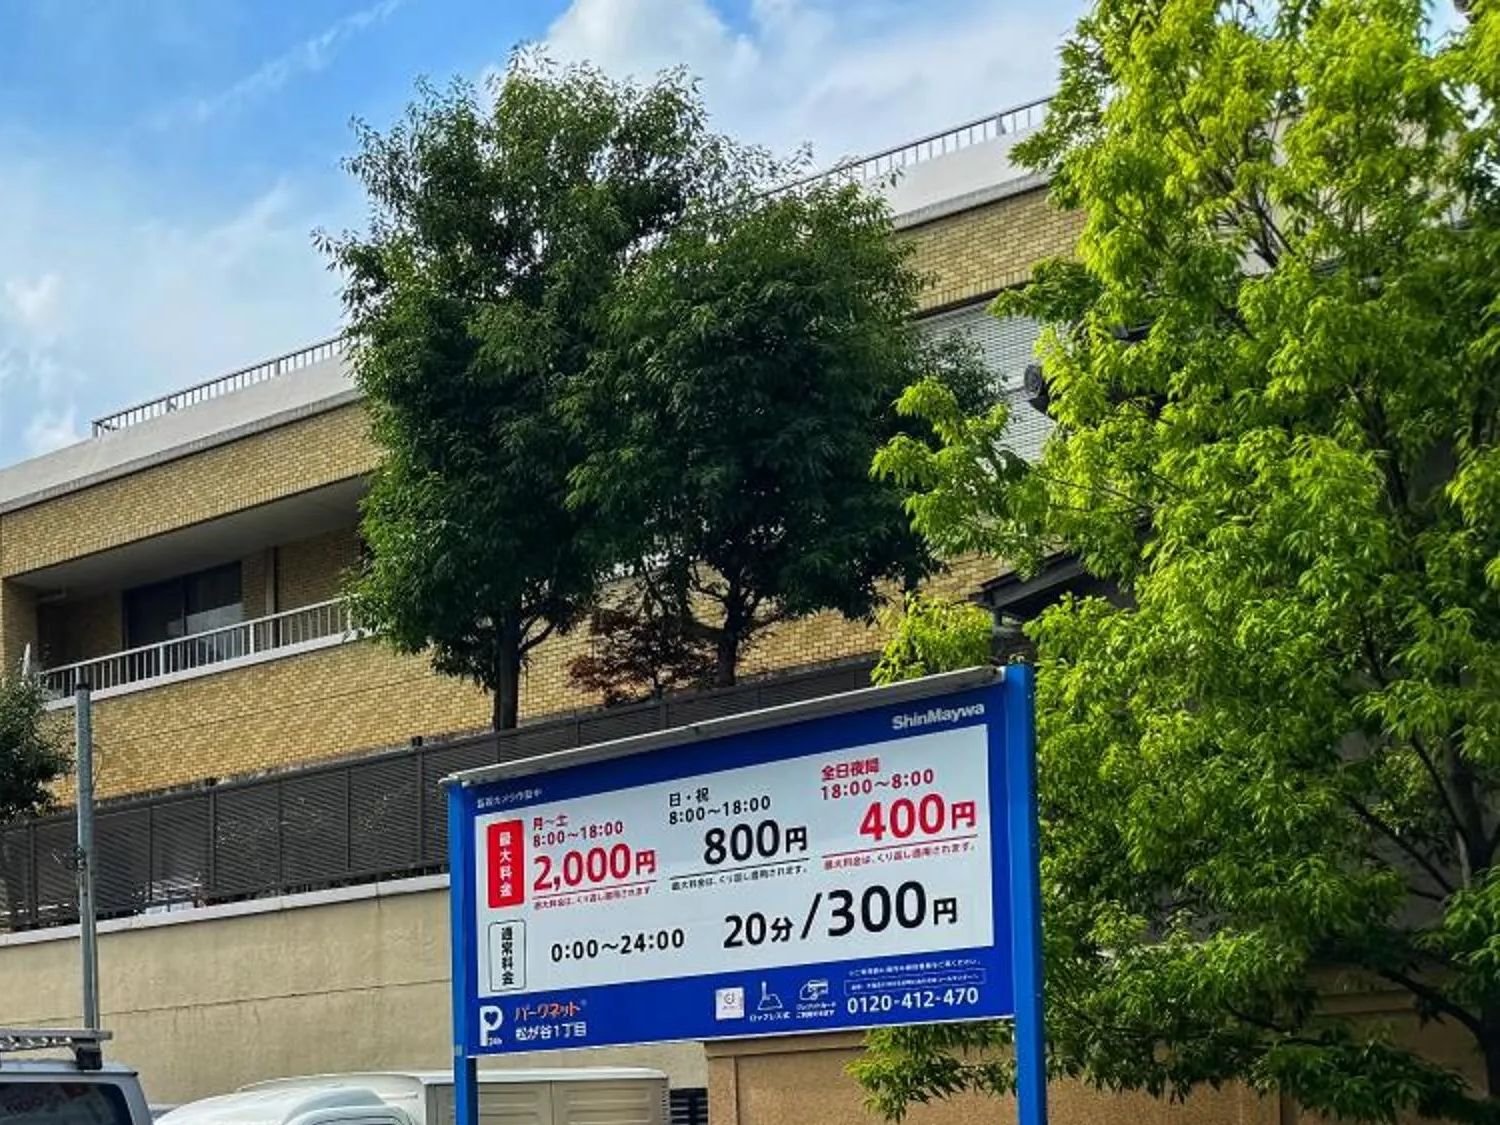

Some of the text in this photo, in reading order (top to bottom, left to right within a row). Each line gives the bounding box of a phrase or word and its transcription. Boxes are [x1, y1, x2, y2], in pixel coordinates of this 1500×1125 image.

[891, 704, 985, 730] ShinMaywa
[821, 757, 879, 782] 全日夜間
[669, 787, 709, 807] 日・祝
[860, 793, 976, 842] 400円
[703, 819, 807, 865] 800円
[498, 831, 513, 897] 最大料金
[533, 843, 656, 892] 2,000円
[501, 926, 515, 986] 通常料金
[514, 1001, 581, 1021] パークネット
[847, 987, 979, 1014] 0120-412-470
